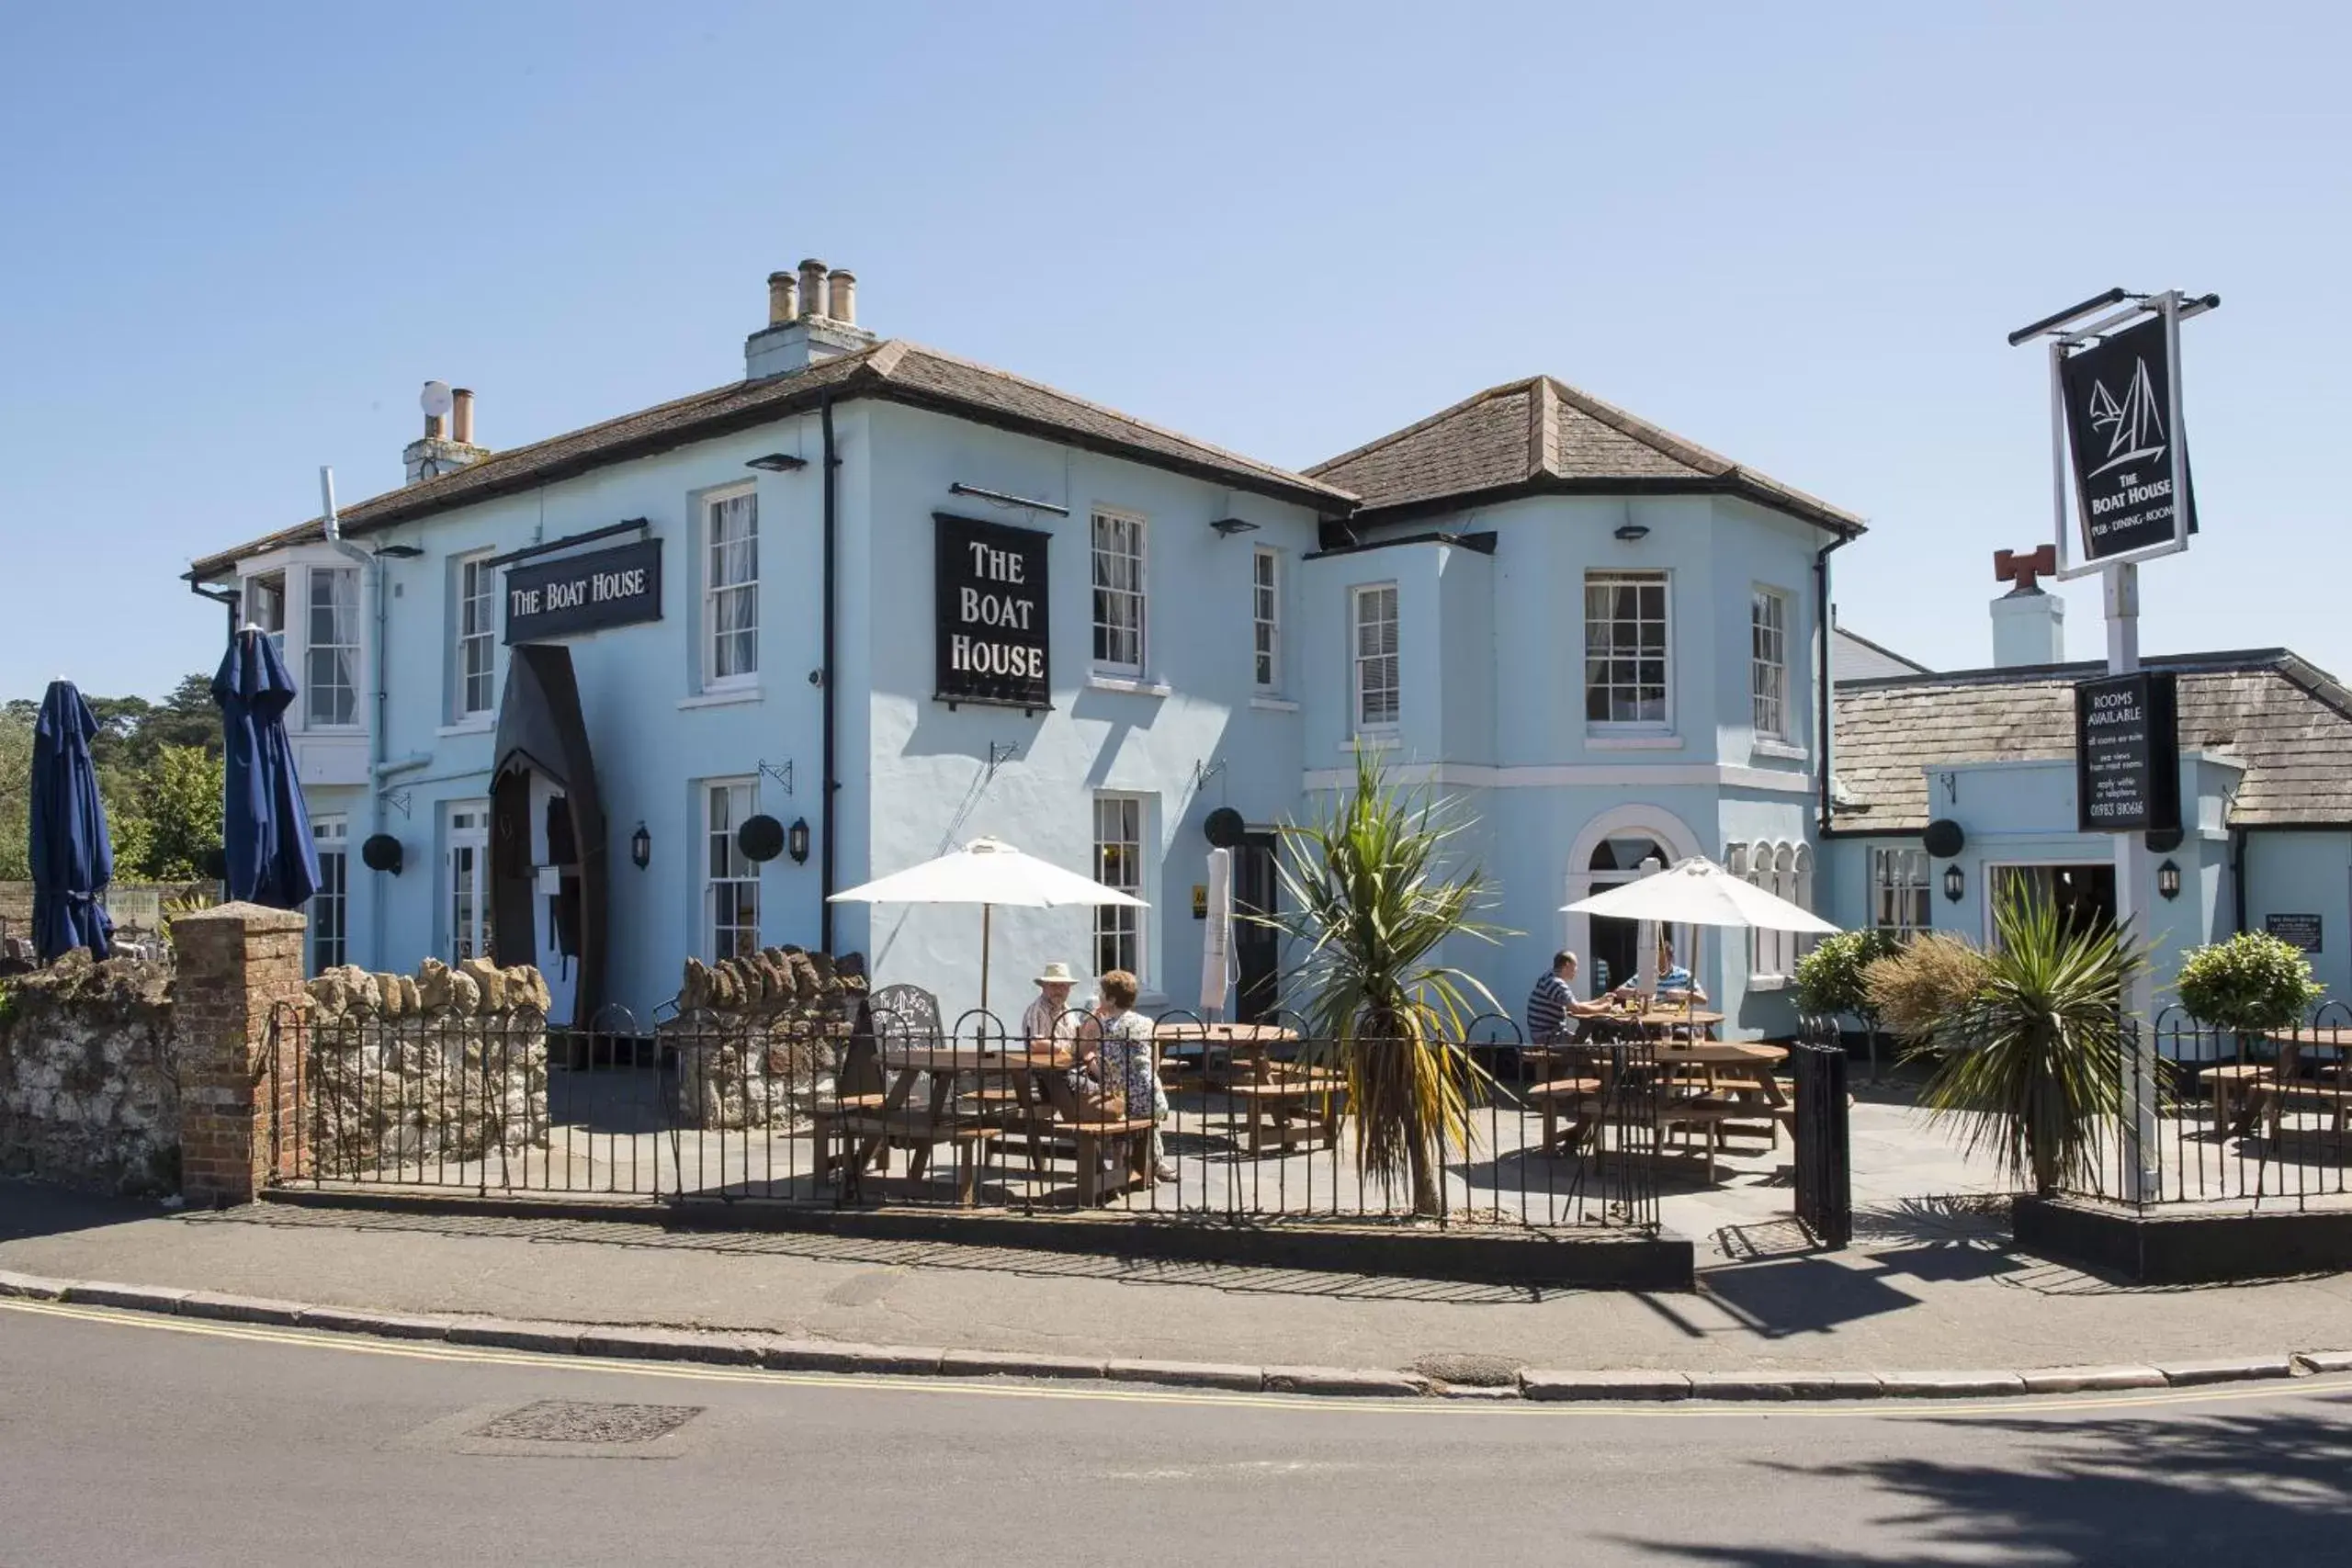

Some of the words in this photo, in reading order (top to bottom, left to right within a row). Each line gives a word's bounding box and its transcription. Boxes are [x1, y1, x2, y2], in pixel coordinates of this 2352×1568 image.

[2092, 492, 2126, 515] BOAT
[2128, 479, 2172, 504] HOUSE
[2120, 472, 2138, 488] THE
[969, 540, 1025, 584] THE
[512, 589, 540, 617] THE
[547, 580, 588, 611] BOAT
[592, 569, 645, 603] HOUSE
[960, 586, 1035, 630] BOAT
[951, 634, 1045, 679] HOUSE
[2087, 705, 2142, 727] AVAILABLE
[2094, 691, 2132, 708] ROOMS
